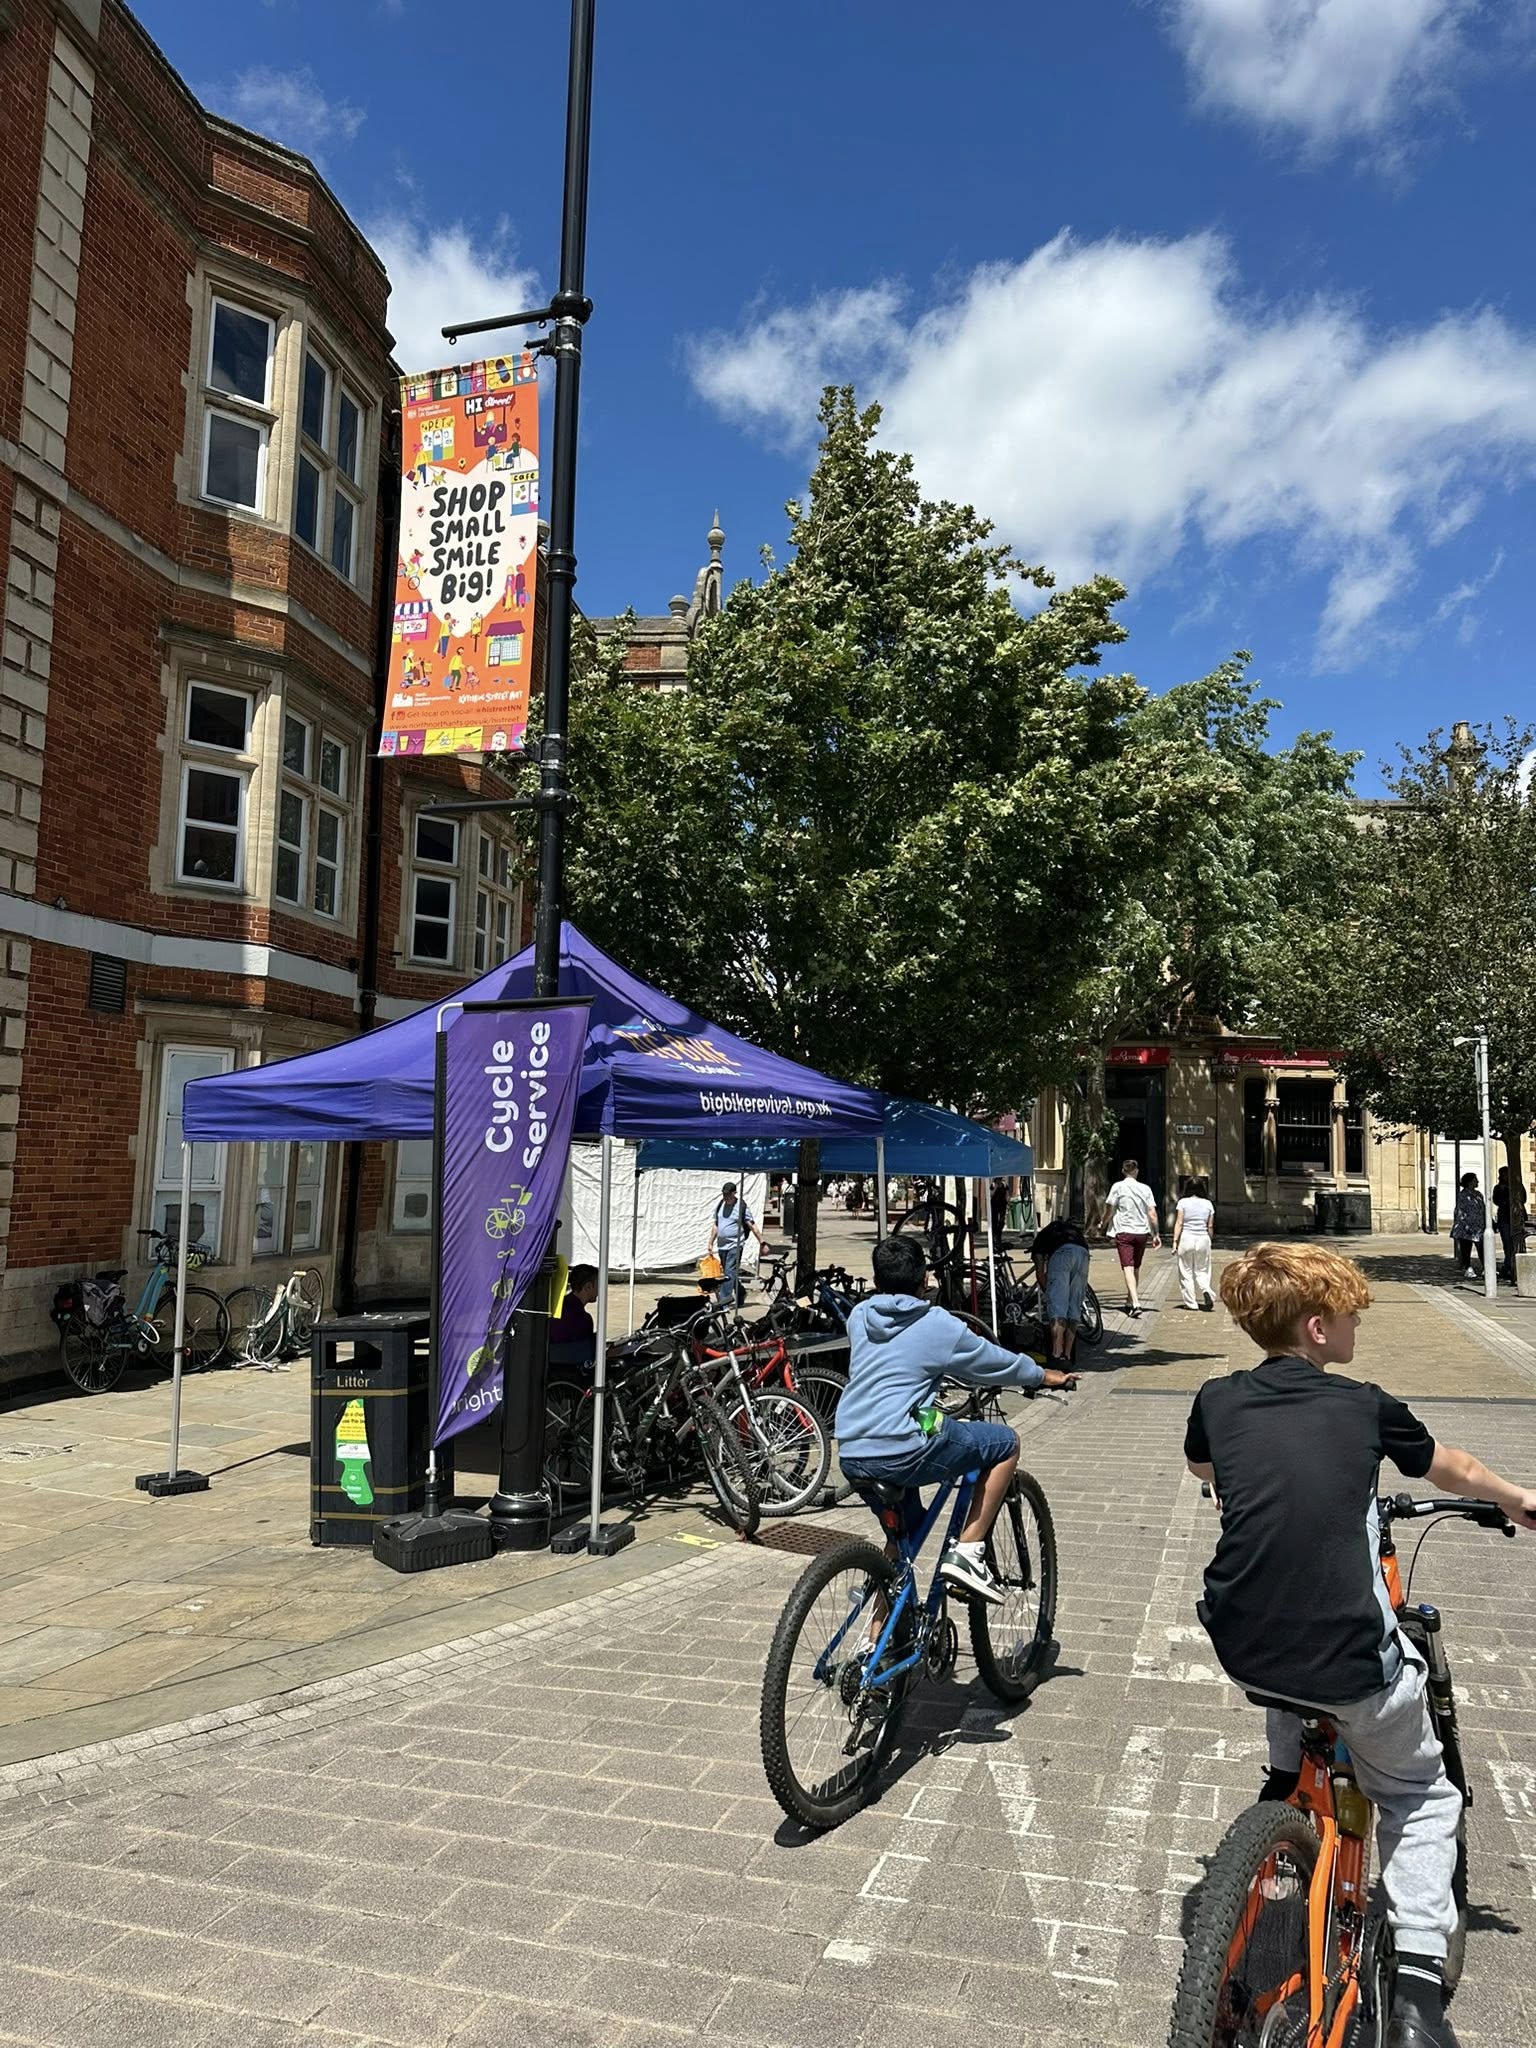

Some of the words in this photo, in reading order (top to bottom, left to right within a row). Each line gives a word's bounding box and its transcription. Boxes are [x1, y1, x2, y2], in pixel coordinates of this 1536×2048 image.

[466, 398, 483, 415] HI
[428, 418, 446, 430] PET
[429, 481, 505, 518] SHOP
[429, 509, 505, 547] SMALL
[421, 709, 438, 717] local
[484, 1040, 519, 1152] Cycle
[520, 1021, 550, 1169] Service
[700, 1091, 832, 1119] bigbikerevival.org.uk
[337, 1375, 370, 1388] Litter
